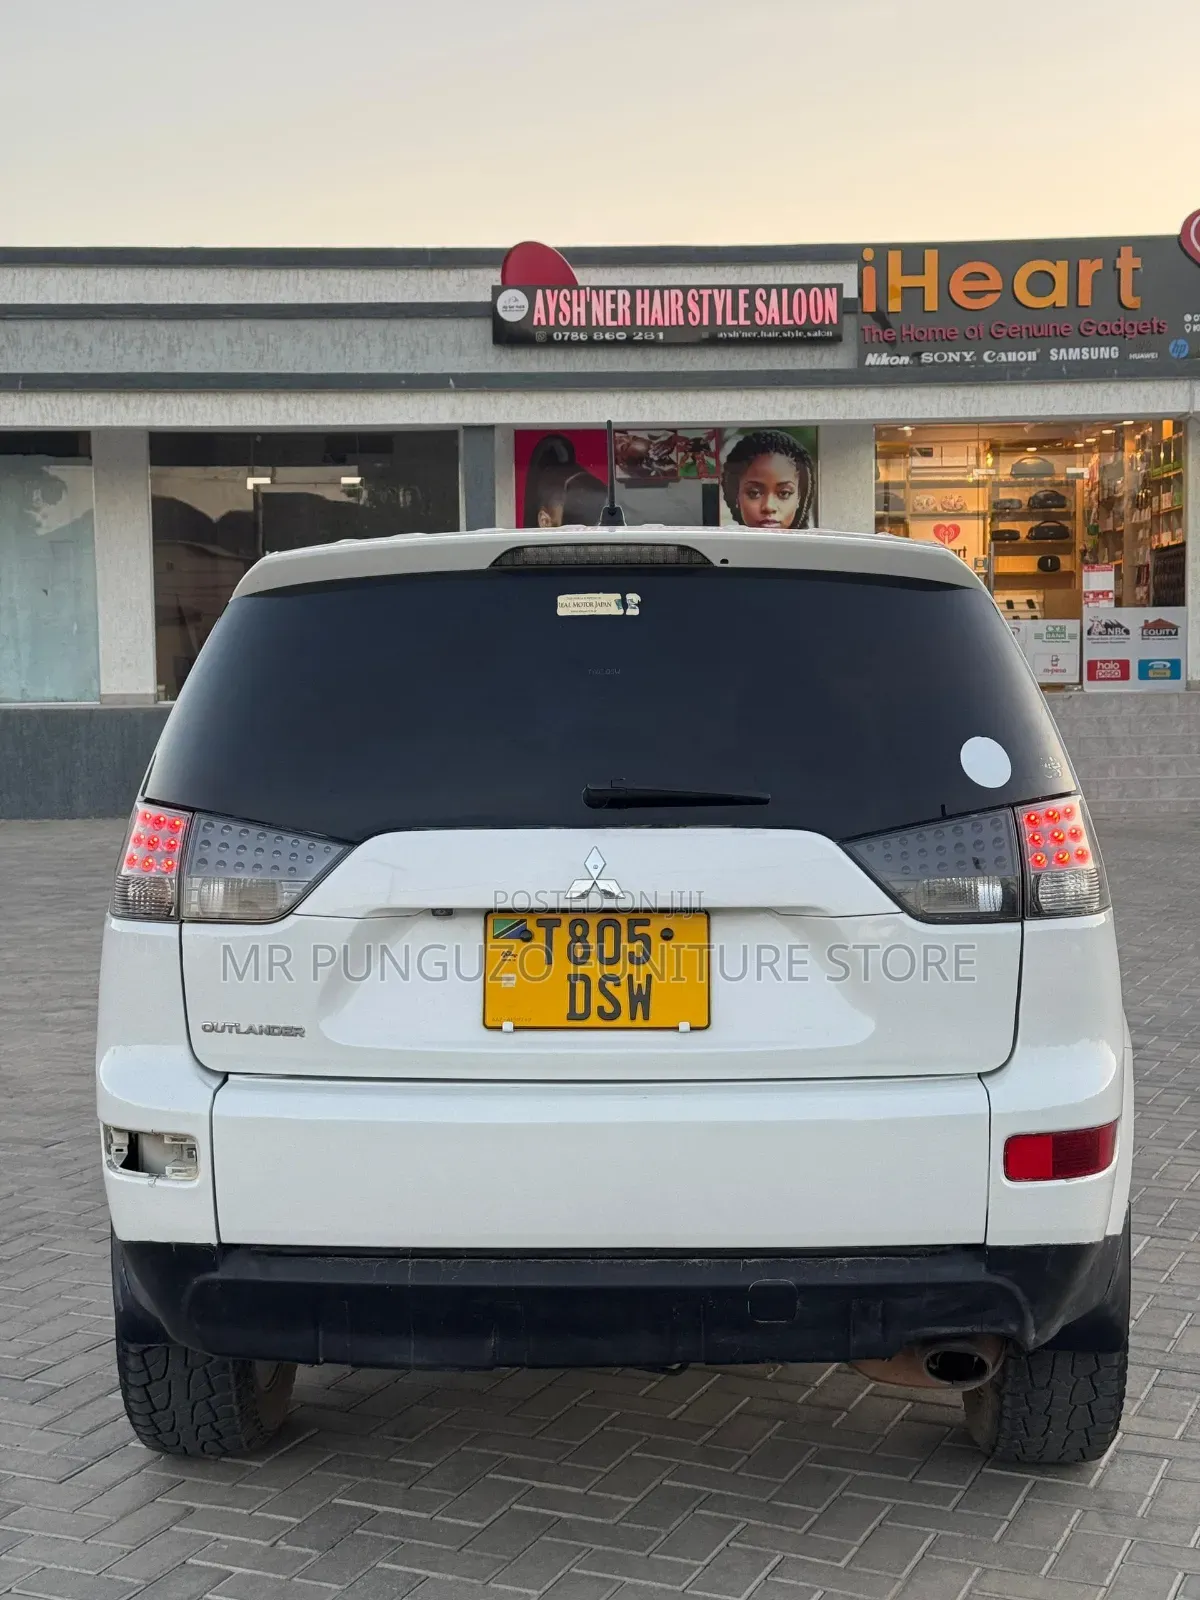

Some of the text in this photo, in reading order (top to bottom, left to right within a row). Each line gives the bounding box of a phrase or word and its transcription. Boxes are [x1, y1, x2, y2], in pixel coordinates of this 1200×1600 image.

[862, 246, 1142, 312] iHeart
[533, 287, 838, 326] AYSH'NER HAIR STYLE SALOON
[553, 331, 664, 341] 0786 860 281
[862, 316, 1168, 343] The Home of Genuine Gadgets
[865, 353, 910, 366] Nikon
[921, 351, 975, 364] SONY
[983, 350, 1037, 363] Canon
[1050, 347, 1120, 361] SAMSUNG
[1129, 352, 1159, 360] HUAWEI
[573, 601, 594, 609] MOTOR
[595, 601, 612, 609] JAPAN
[1107, 628, 1126, 636] NBC
[1143, 628, 1176, 636] EQUITY
[1097, 661, 1120, 670] halo
[1097, 670, 1121, 679] pesa
[537, 918, 651, 966] T805
[567, 973, 652, 1021] DSW
[201, 1021, 306, 1038] OUTLANDER
